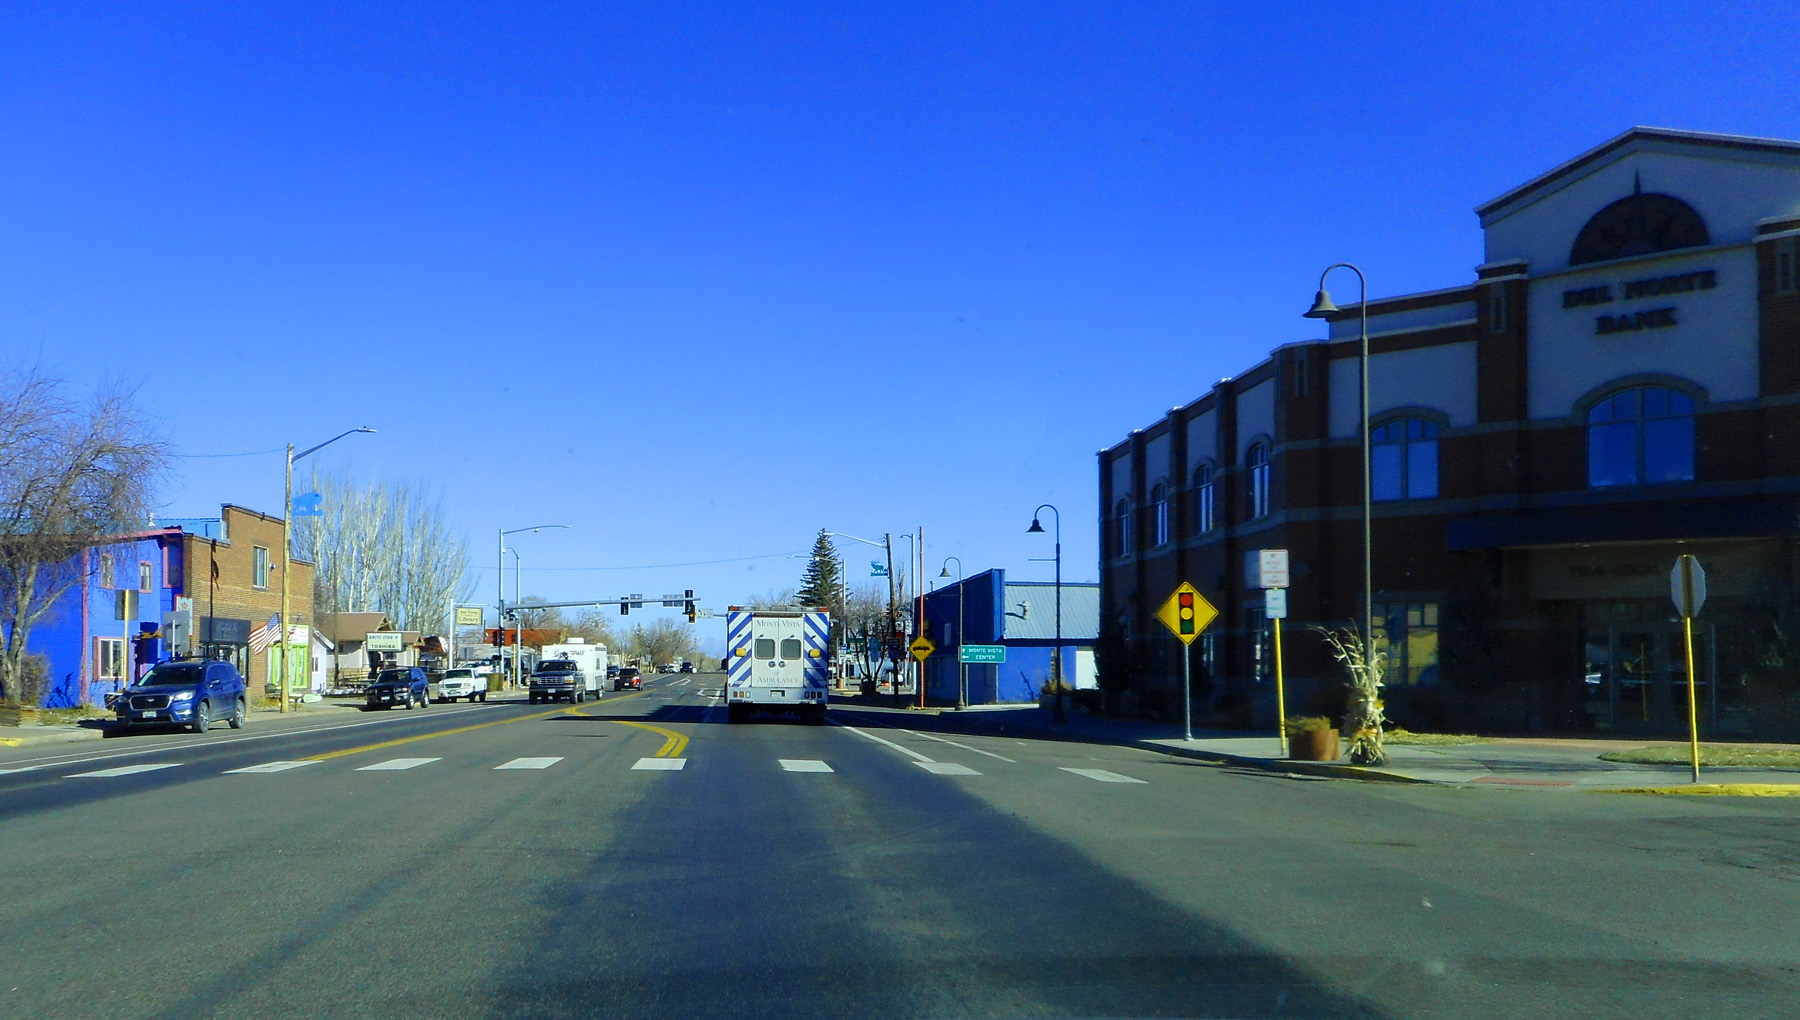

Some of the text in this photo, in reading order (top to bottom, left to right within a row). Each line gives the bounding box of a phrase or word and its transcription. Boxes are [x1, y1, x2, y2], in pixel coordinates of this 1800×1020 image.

[1562, 270, 1717, 309] DEL NORTE
[1596, 307, 1679, 335] BANK
[756, 620, 801, 628] MONTE VISTA
